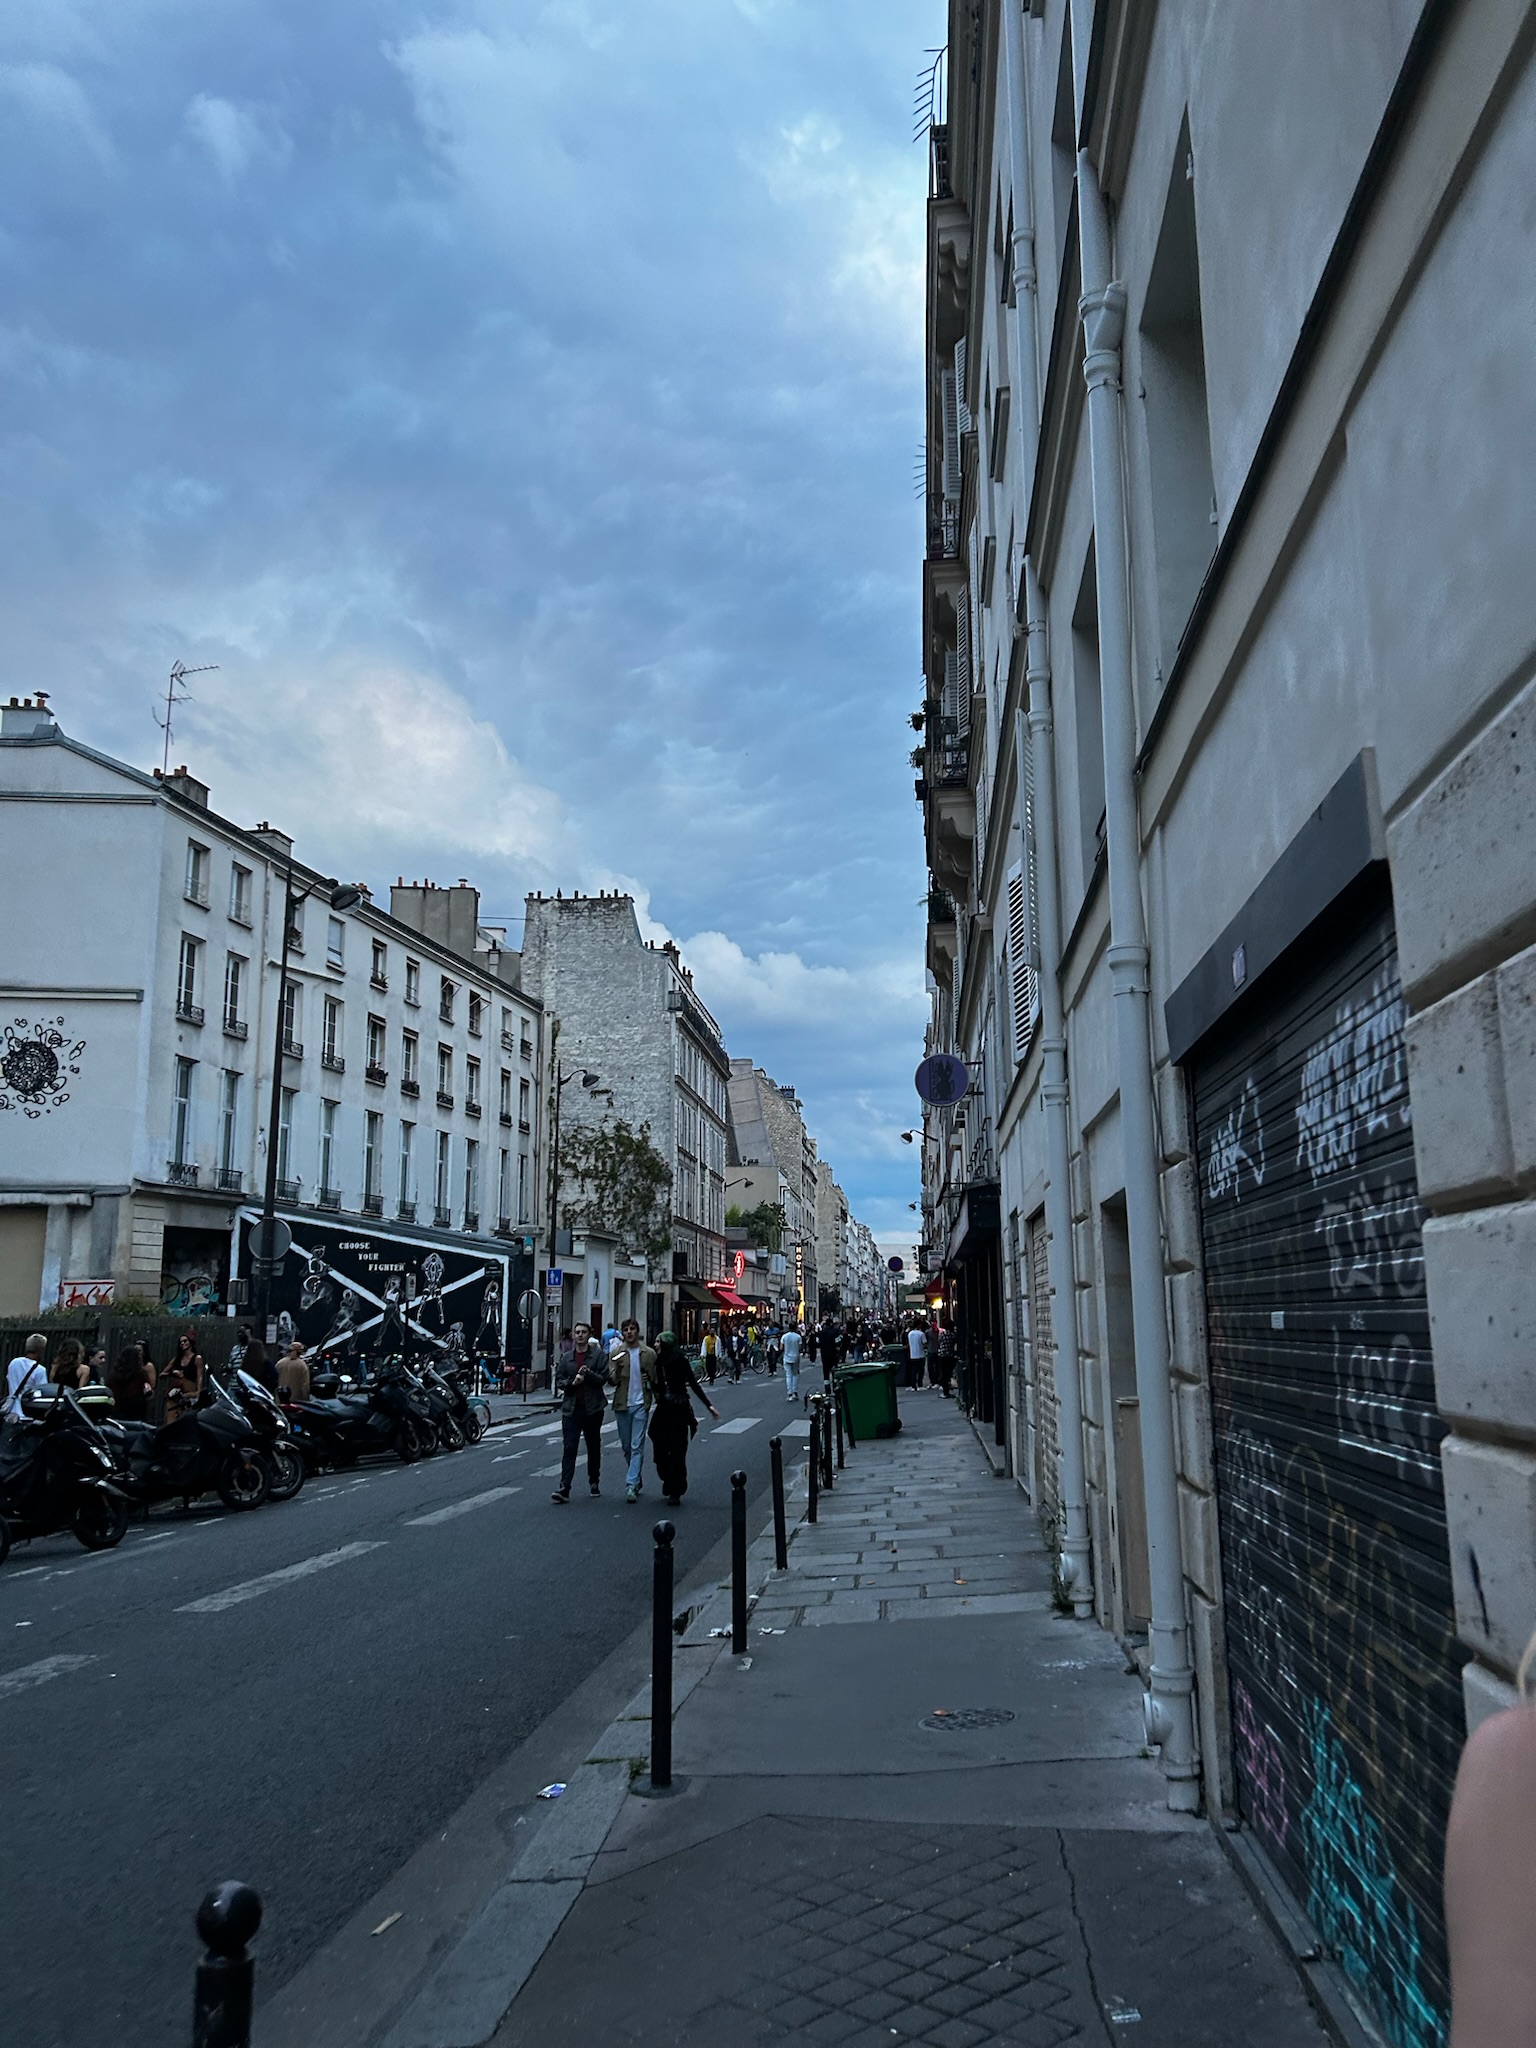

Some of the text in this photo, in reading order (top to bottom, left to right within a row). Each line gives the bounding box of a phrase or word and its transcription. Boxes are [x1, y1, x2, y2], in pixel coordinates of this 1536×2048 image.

[338, 1242, 371, 1250] CHOOSE
[368, 1263, 405, 1271] FIGHTER
[795, 1246, 803, 1284] HOTEL
